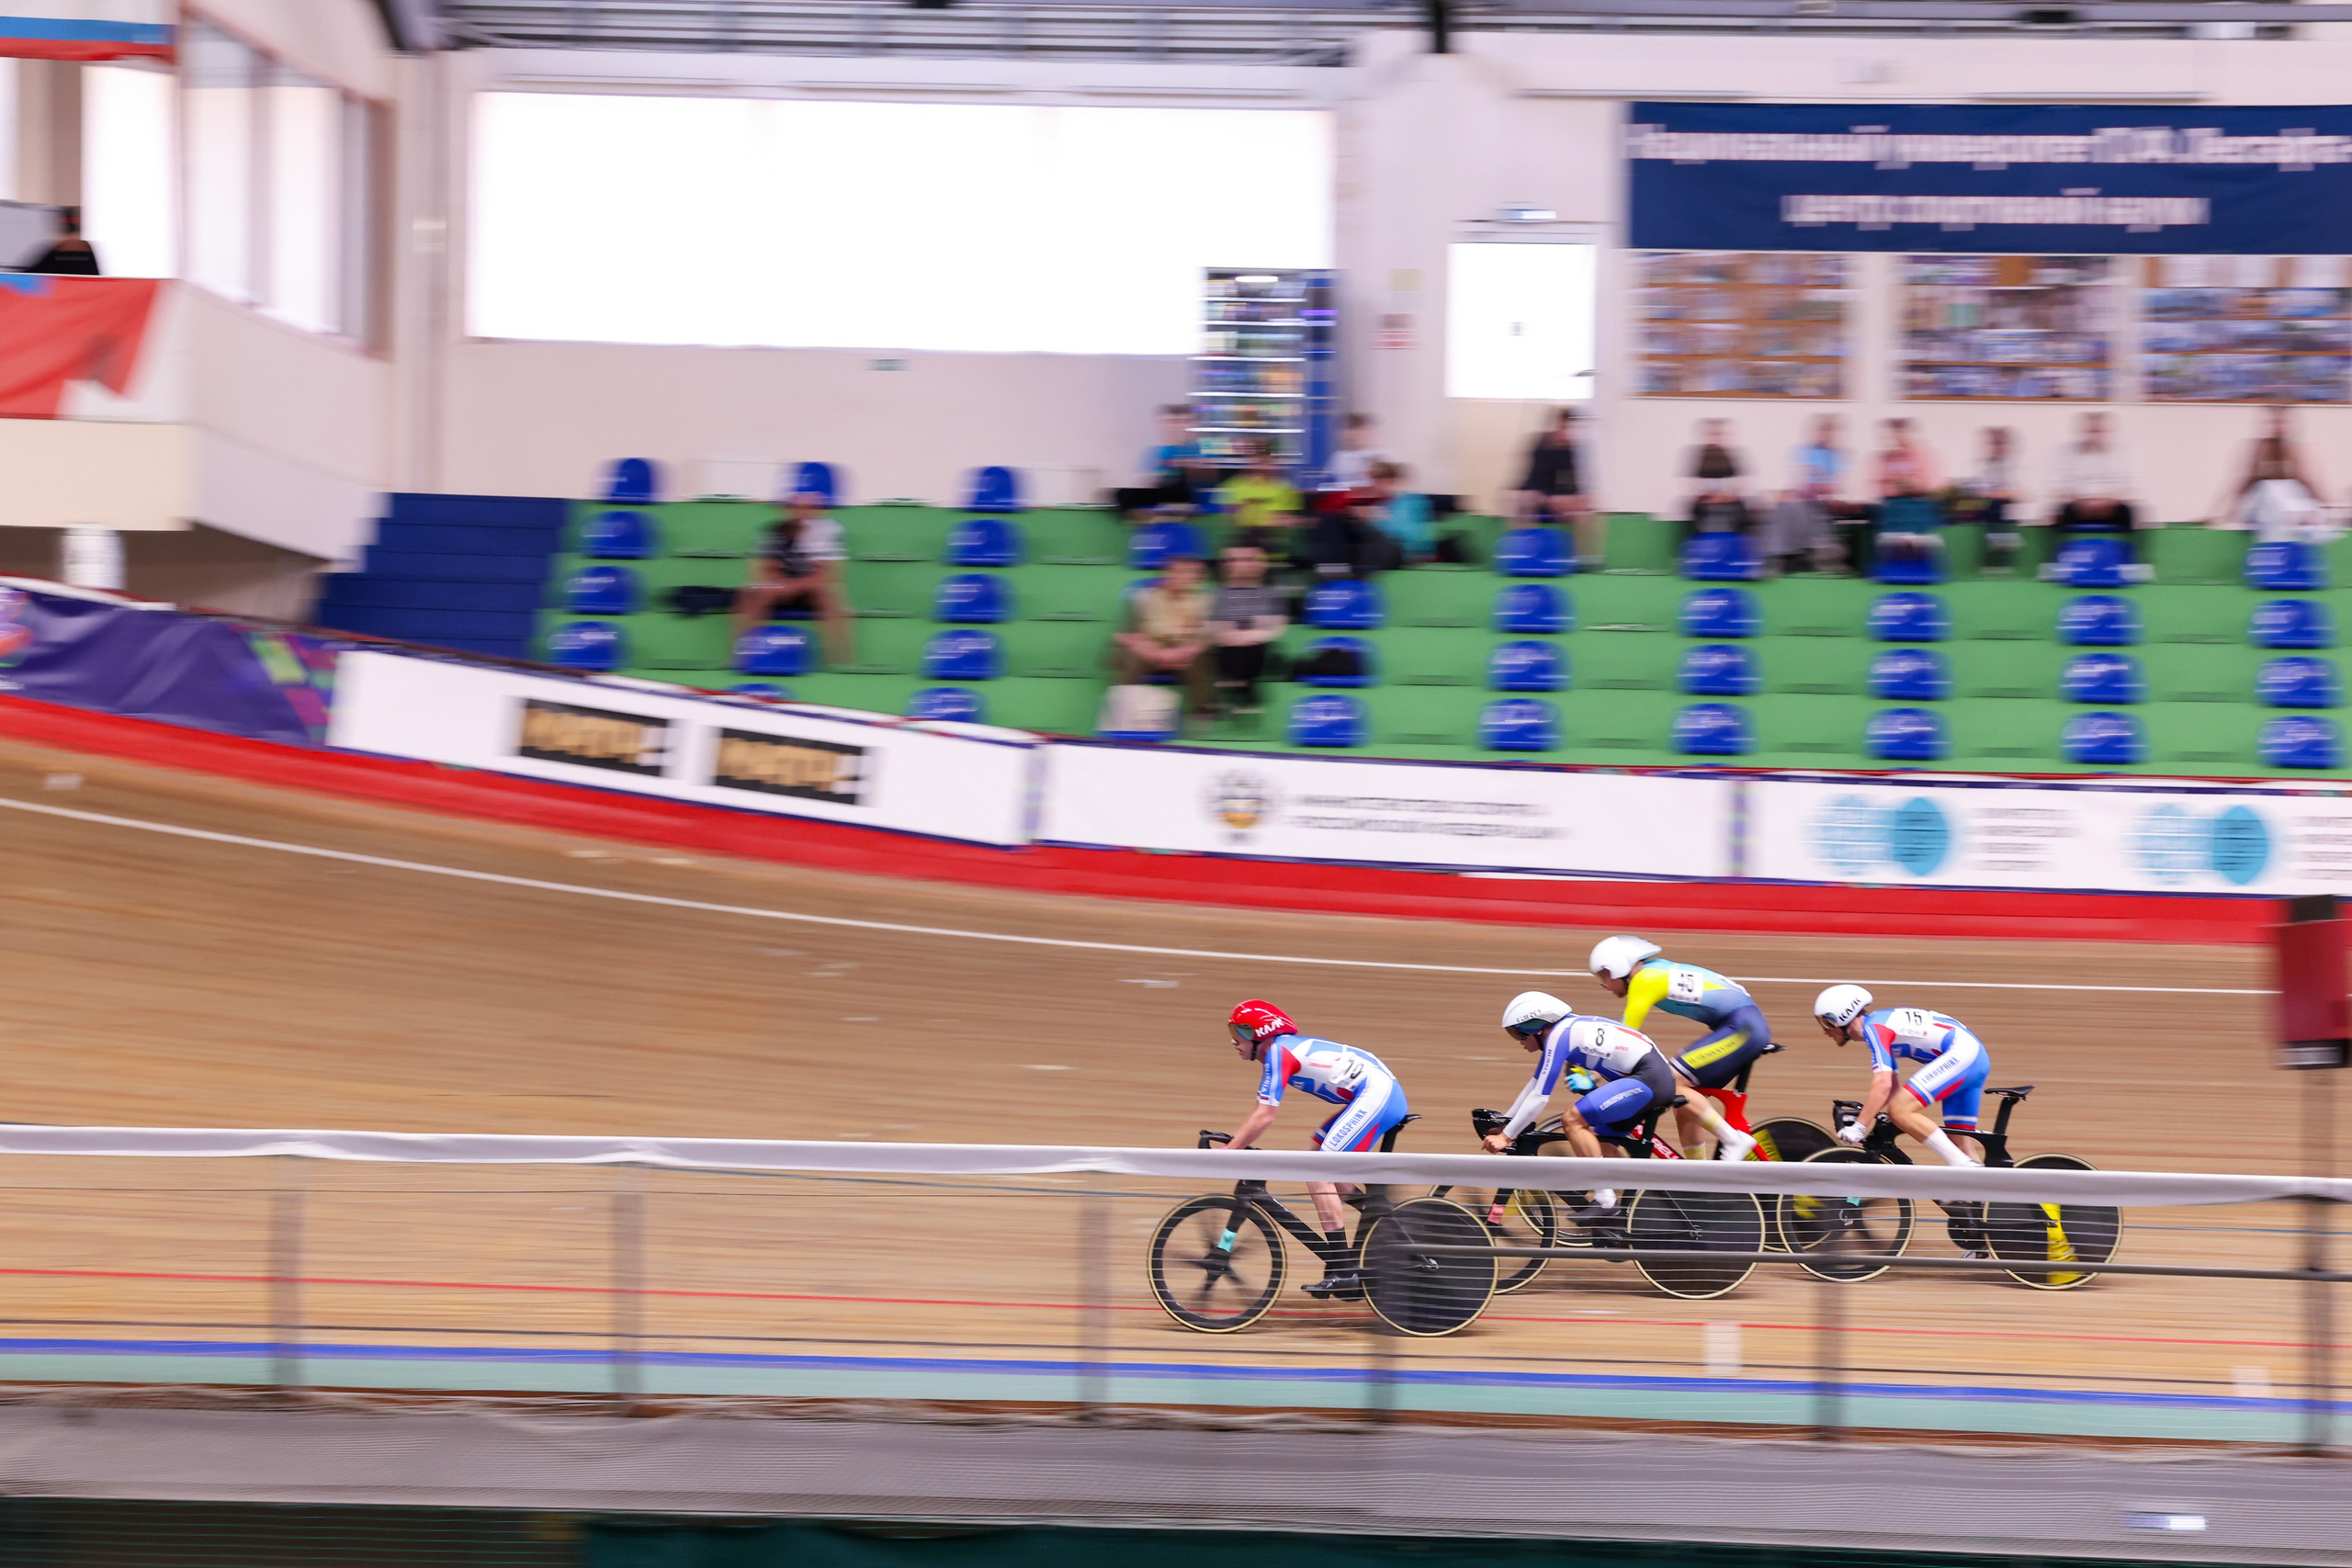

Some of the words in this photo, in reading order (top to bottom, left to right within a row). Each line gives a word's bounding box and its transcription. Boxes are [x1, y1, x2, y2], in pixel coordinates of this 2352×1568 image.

[1905, 1011, 1923, 1026] 15
[1595, 1028, 1605, 1046] 8
[1329, 1109, 1367, 1146] LOKOSPHINX
